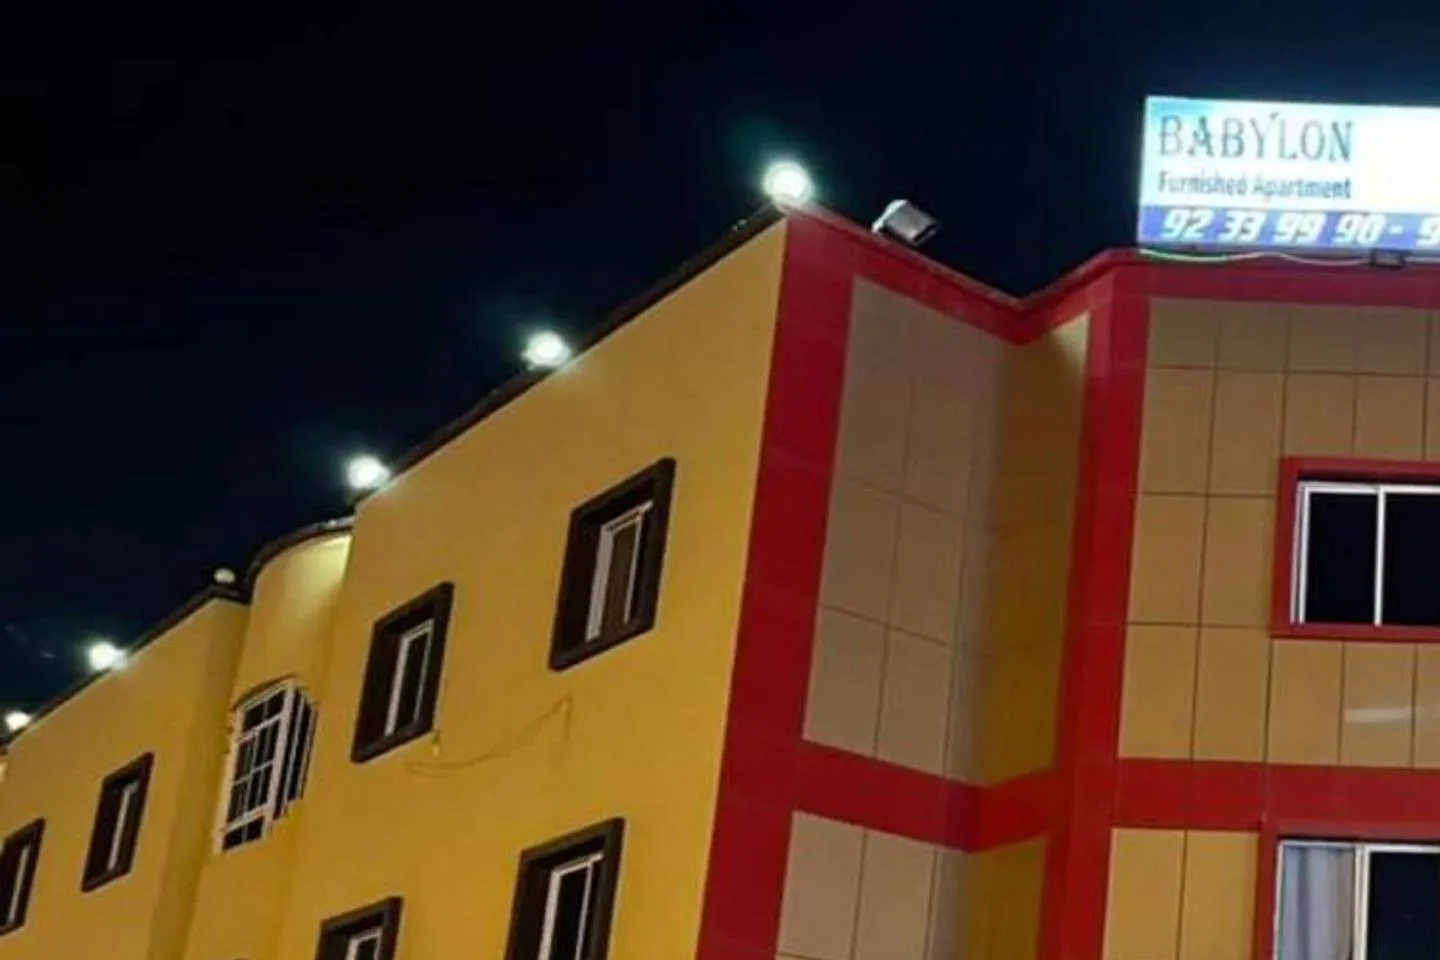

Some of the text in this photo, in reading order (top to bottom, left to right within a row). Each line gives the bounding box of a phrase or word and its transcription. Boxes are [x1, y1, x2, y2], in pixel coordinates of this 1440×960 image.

[1158, 111, 1353, 163] BABYLON
[1158, 169, 1351, 202] Furnished Apartment
